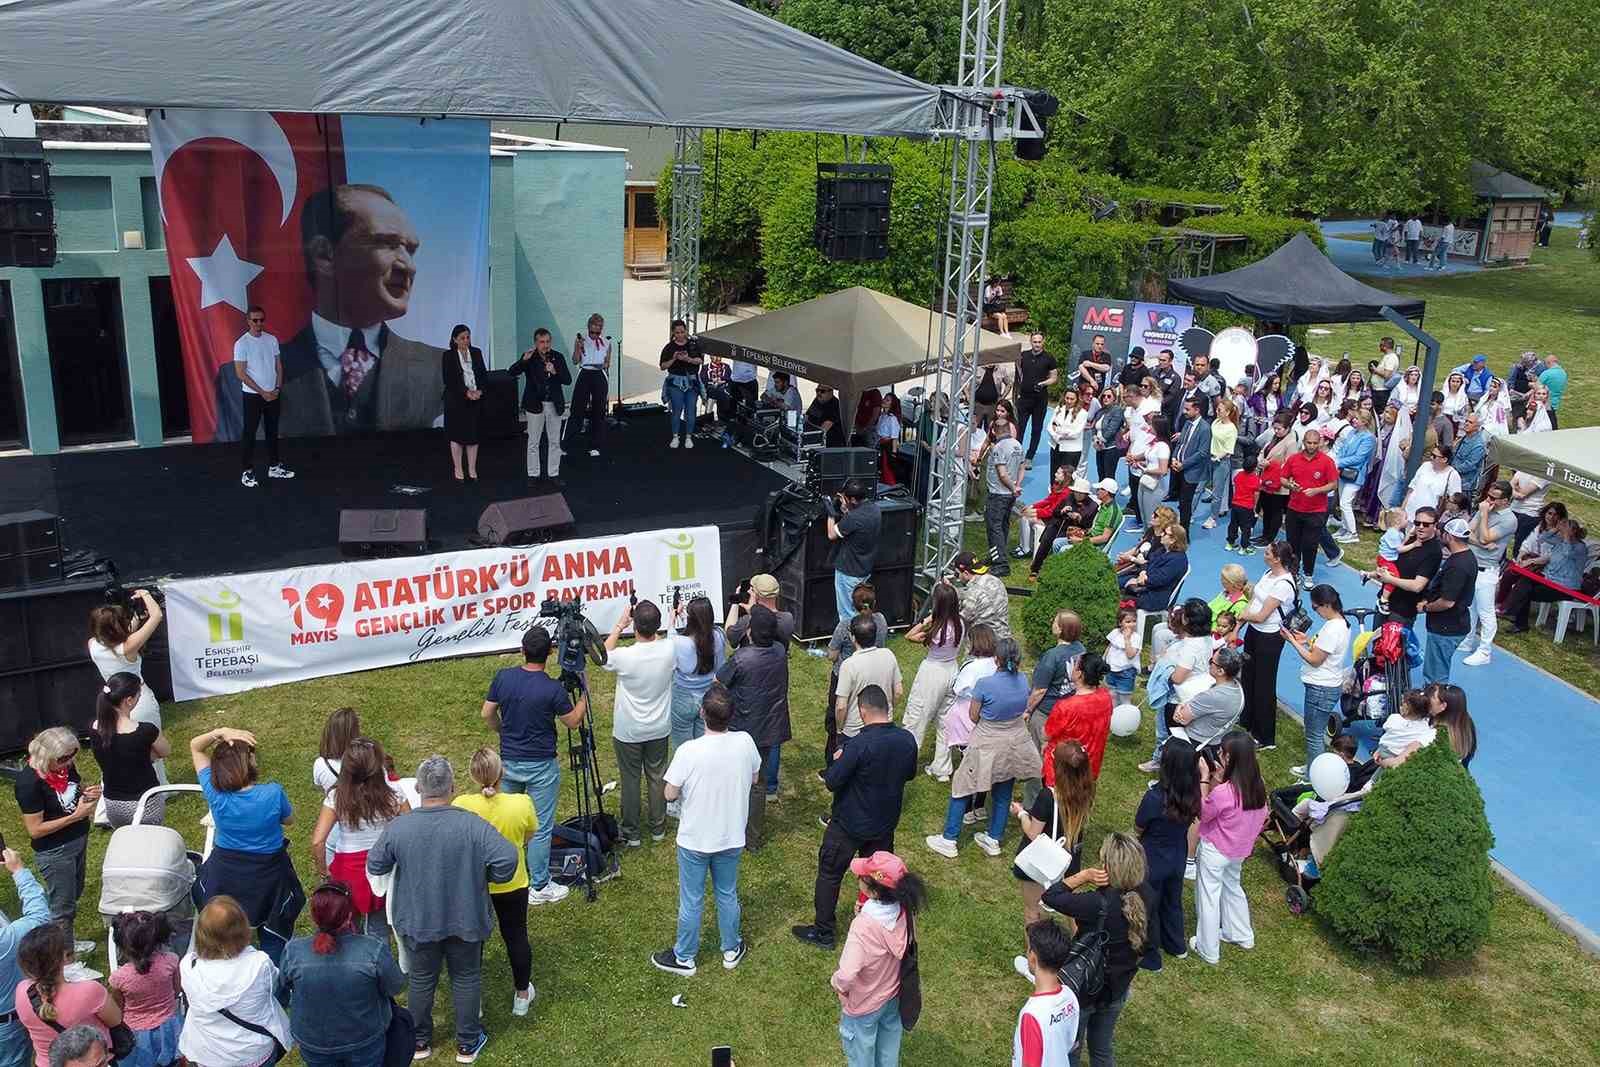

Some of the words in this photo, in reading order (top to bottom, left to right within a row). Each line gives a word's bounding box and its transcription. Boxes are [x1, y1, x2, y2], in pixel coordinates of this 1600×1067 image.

[1084, 305, 1124, 327] MG
[542, 546, 632, 582] ANMA
[280, 582, 345, 631] 19
[355, 605, 446, 638] GENÇLİK
[452, 602, 477, 621] VE
[484, 592, 536, 617] SPOR
[290, 629, 339, 646] MAYIS
[194, 654, 259, 669] TEPEBAŞI
